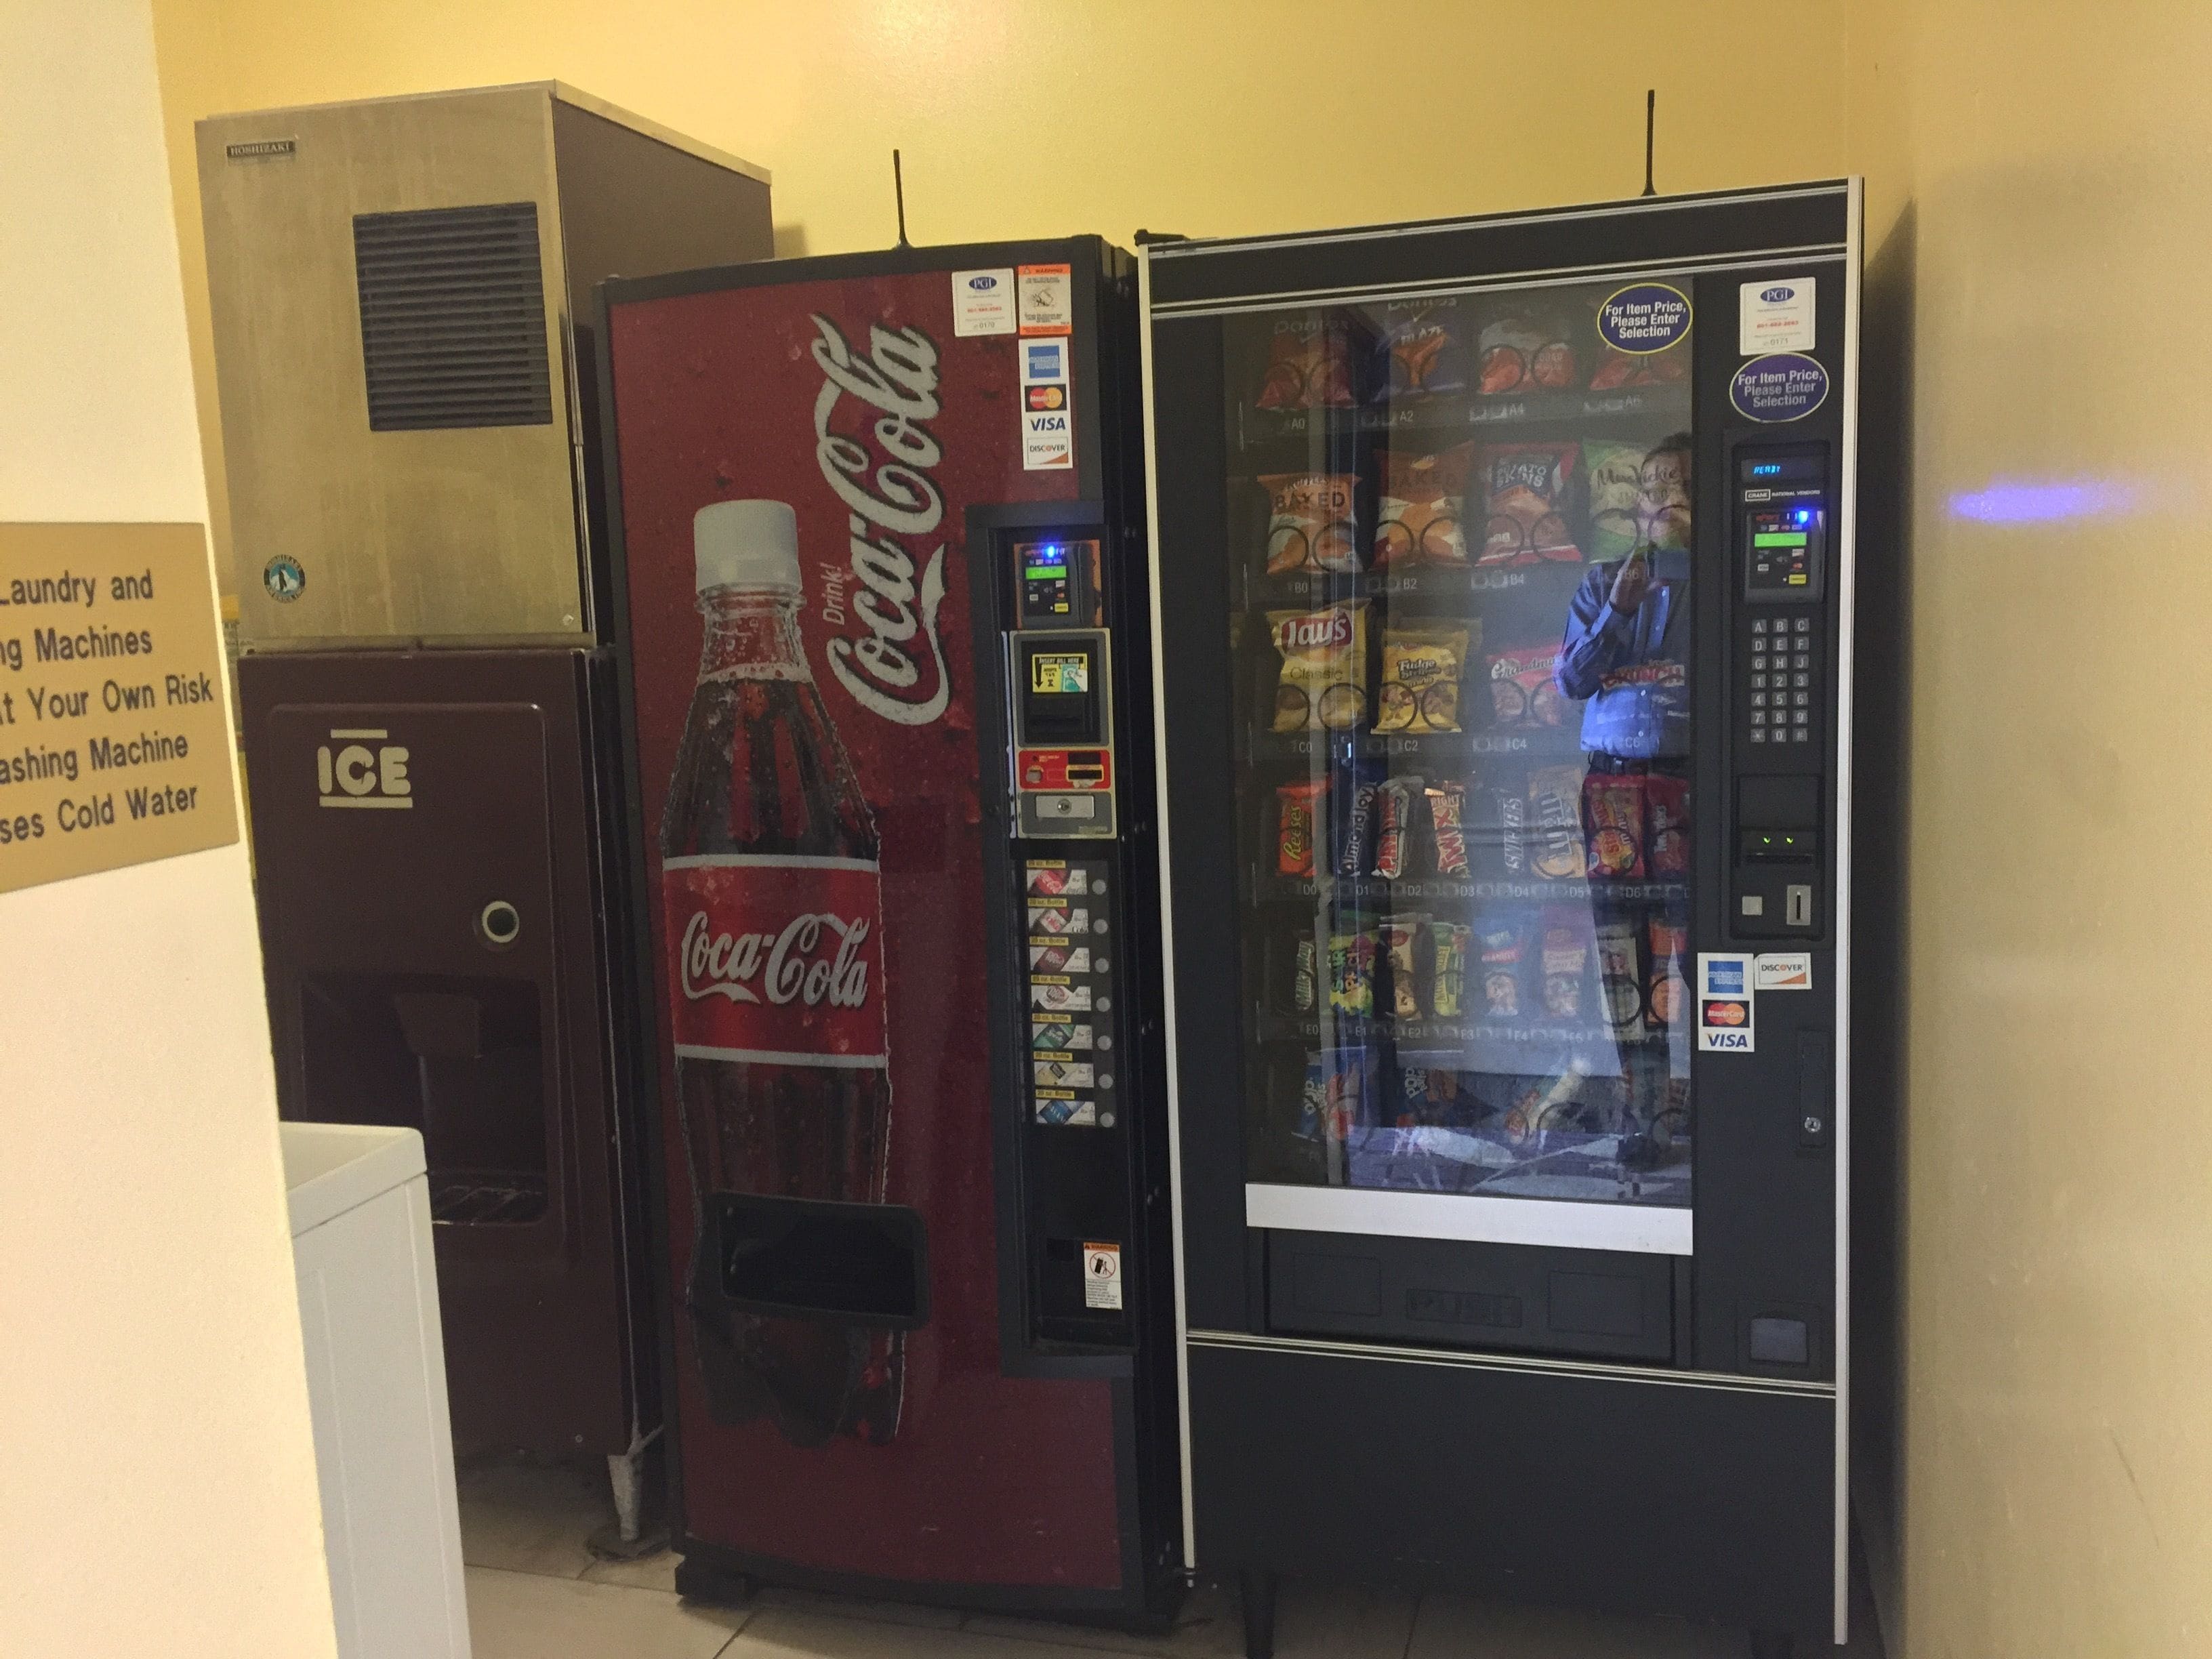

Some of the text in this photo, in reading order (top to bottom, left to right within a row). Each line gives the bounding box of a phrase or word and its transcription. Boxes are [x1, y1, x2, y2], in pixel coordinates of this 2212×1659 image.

[230, 143, 289, 155] HOSHIZAKI
[1767, 289, 1788, 301] PGI
[1606, 302, 1686, 315] For Item Price,
[1611, 314, 1680, 327] Please Enter
[1619, 325, 1671, 339] Selection
[1738, 370, 1822, 386] For Item Price,
[1744, 383, 1816, 396] Please Enter
[1753, 395, 1807, 407] Selection
[1400, 411, 1414, 422] A2
[1031, 417, 1066, 432] VISA
[1029, 444, 1065, 452] DISCOVER
[811, 312, 949, 726] Coca-Cola
[110, 569, 154, 601] and
[822, 562, 846, 626] Drink!
[1777, 621, 1784, 630] B
[1797, 621, 1805, 629] C
[34, 624, 152, 663] Machines
[1798, 639, 1804, 647] F
[1398, 659, 1435, 672] Fudge
[1755, 659, 1762, 668] G
[1798, 658, 1804, 666] J
[1290, 668, 1343, 680] Classic
[1797, 676, 1804, 684] 3
[27, 686, 89, 721] Your
[102, 680, 155, 713] Own
[165, 672, 214, 706] Risk
[1755, 695, 1804, 703] 4 5 6
[1755, 713, 1804, 722] 7 8 9
[1776, 732, 1782, 740] 0
[89, 731, 189, 771] Machine
[1404, 740, 1418, 751] C2
[317, 745, 411, 796] ICE
[1431, 795, 1459, 806] RIGHT
[58, 793, 115, 833] Cold
[125, 785, 198, 820] Water
[1408, 886, 1421, 897] D2
[1461, 886, 1475, 897] D3
[681, 911, 871, 1008] Coca-Cola
[1761, 964, 1803, 972] DISCOVER
[1707, 1010, 1745, 1018] MasterCard
[1708, 1033, 1748, 1048] VISA
